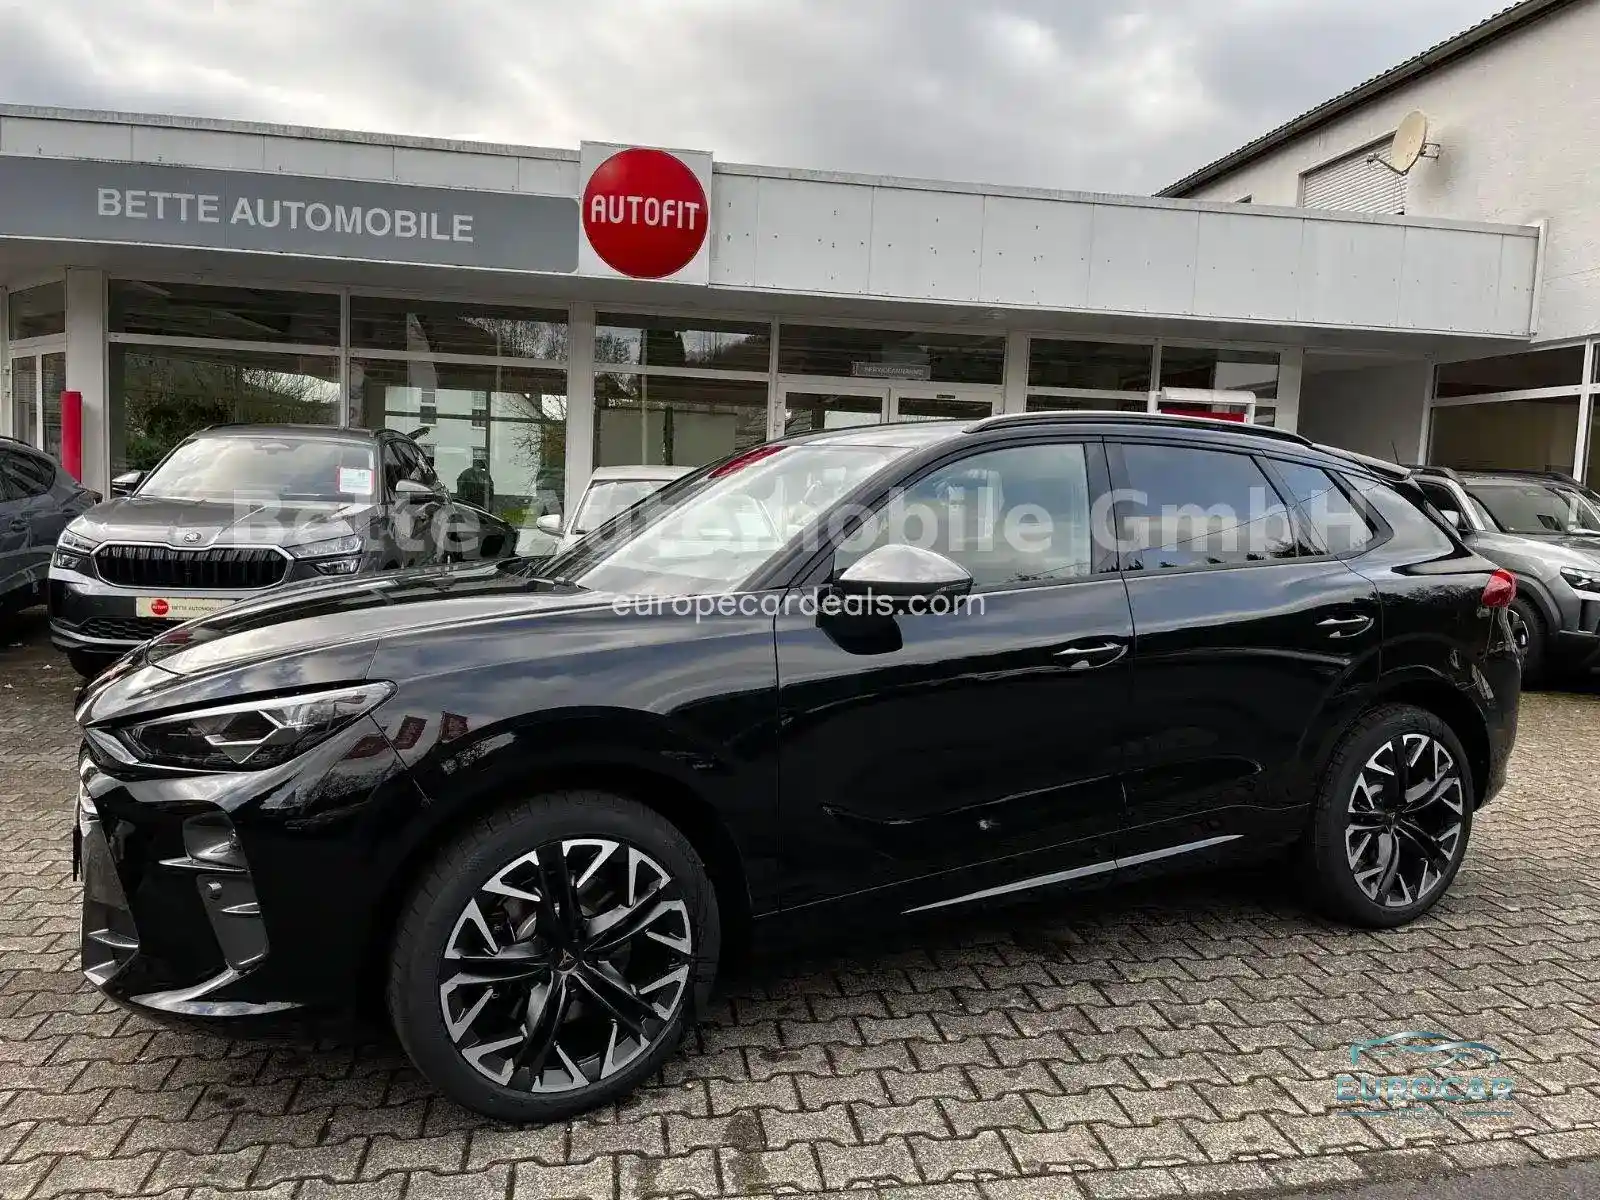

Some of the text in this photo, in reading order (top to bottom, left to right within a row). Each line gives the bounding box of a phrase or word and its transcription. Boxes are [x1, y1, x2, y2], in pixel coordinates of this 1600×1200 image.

[97, 187, 474, 243] BETTE AUTOMOBILE
[590, 194, 700, 230] AUTOFIT
